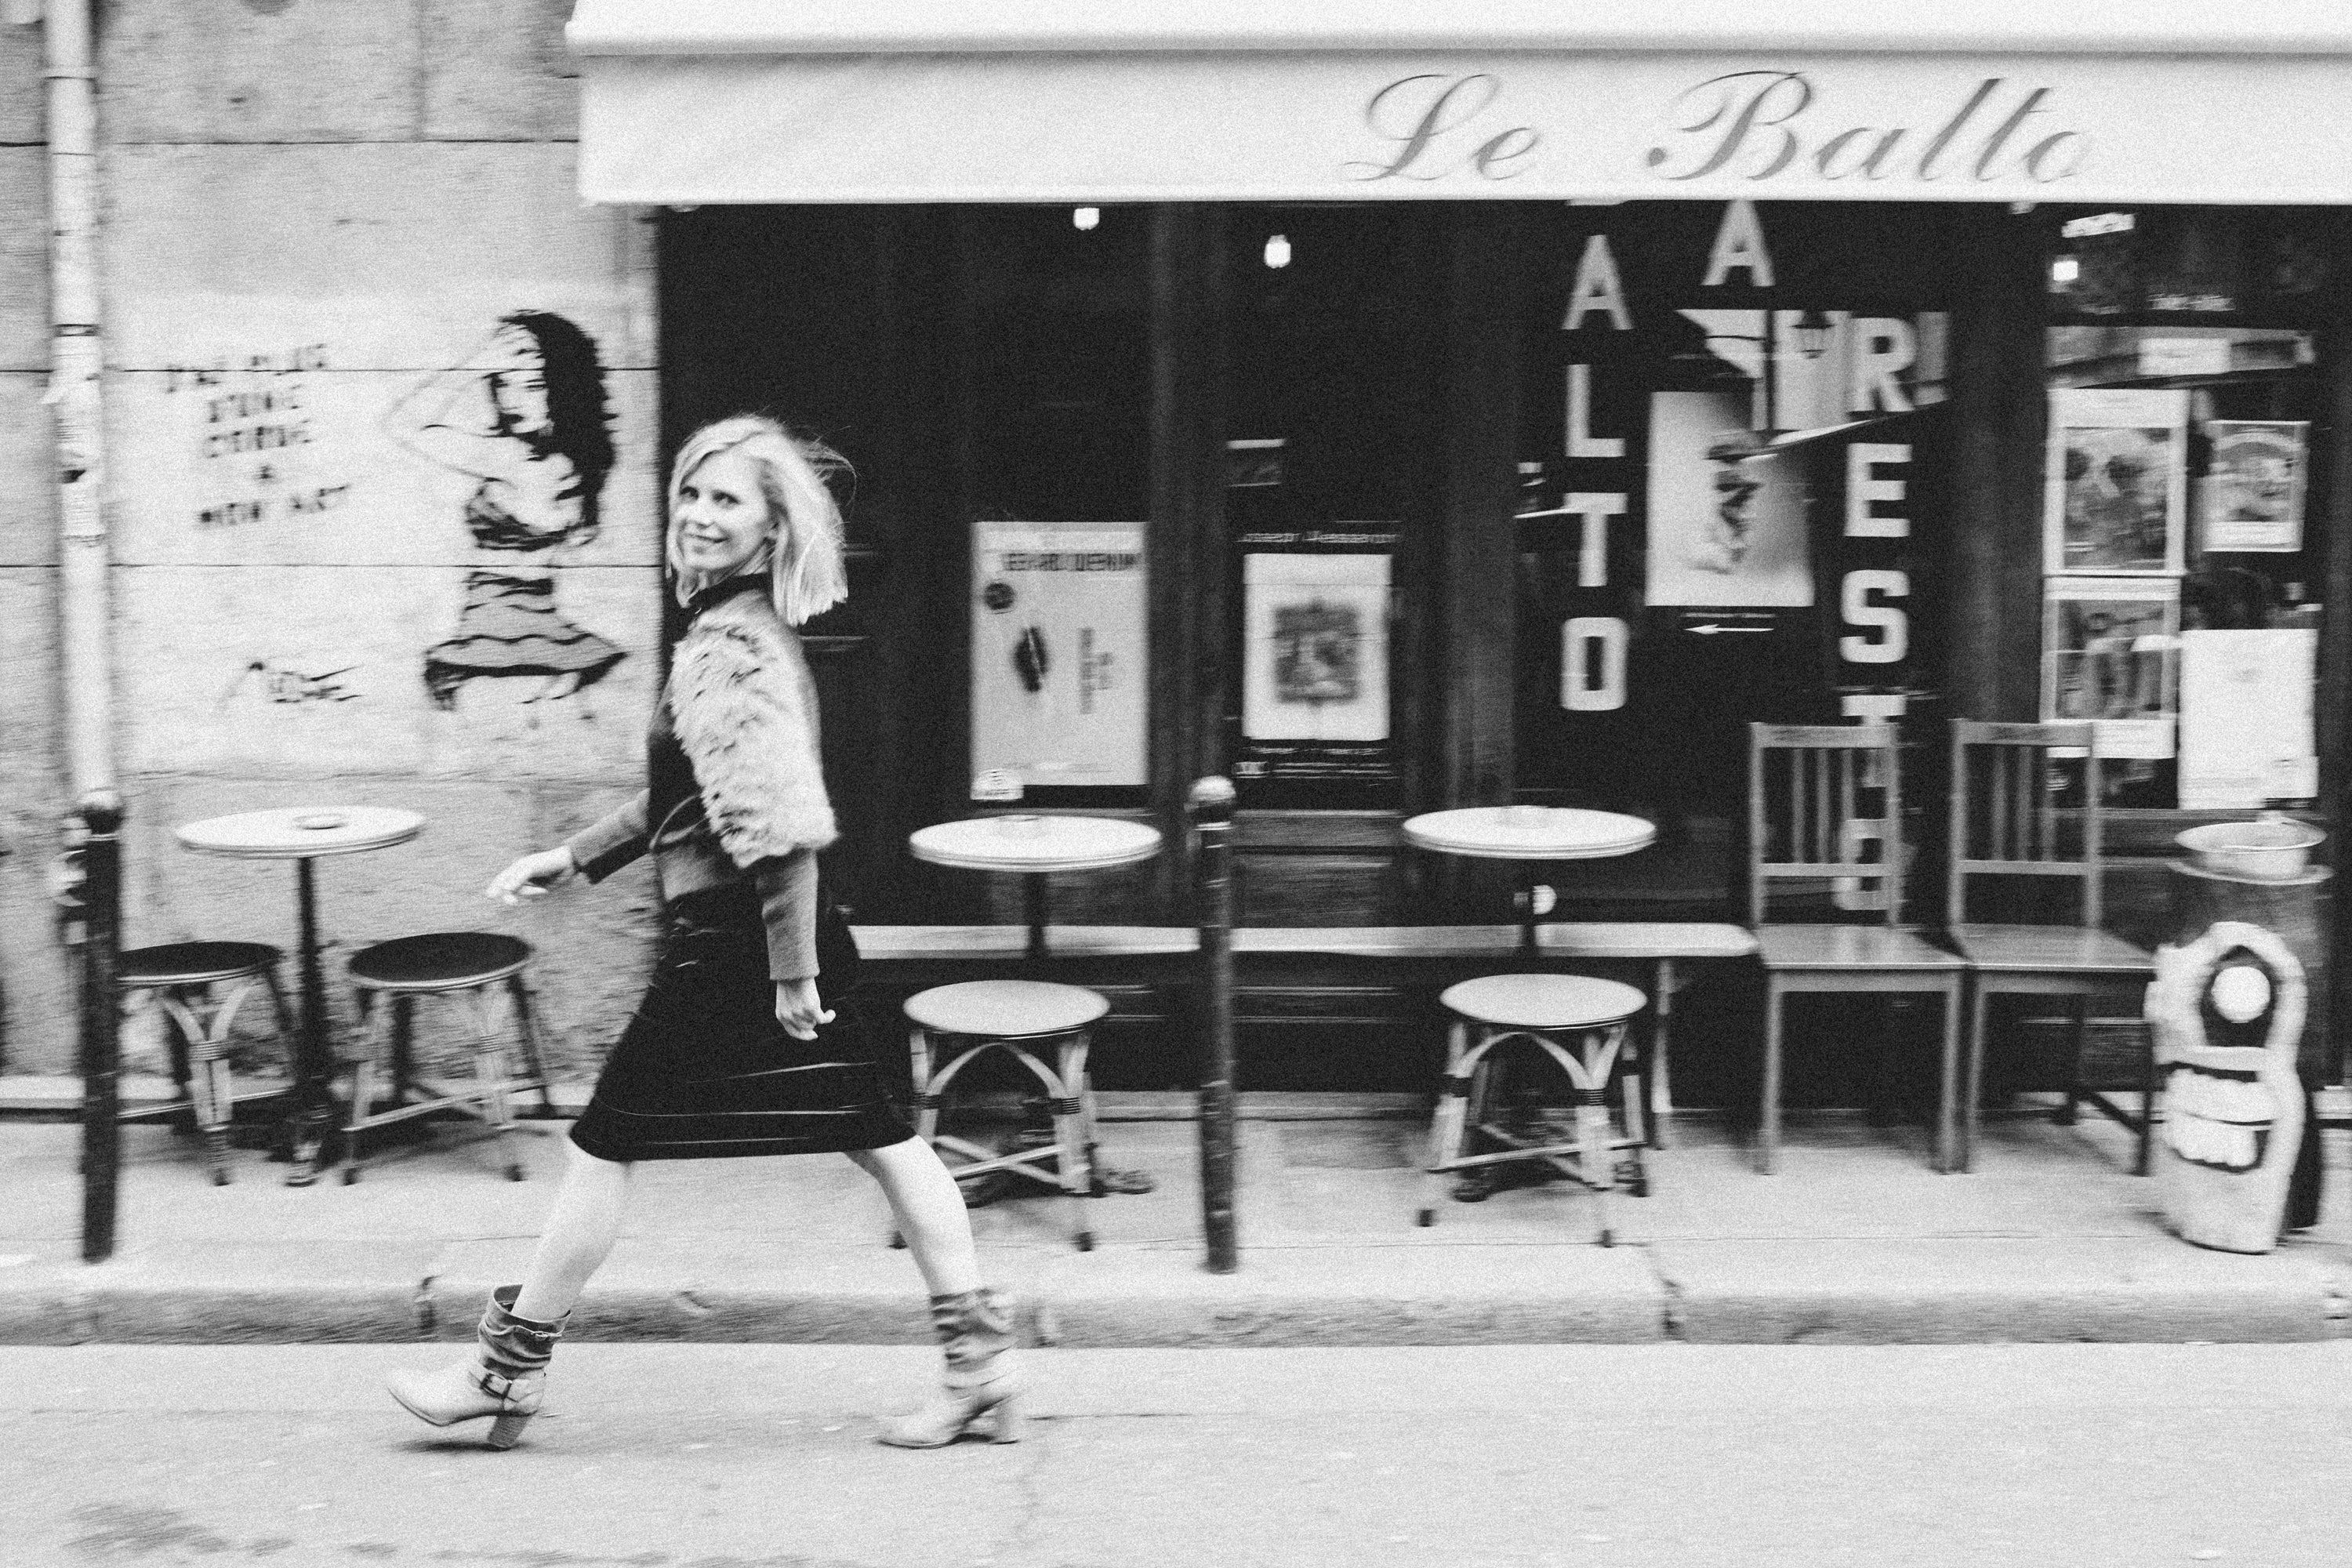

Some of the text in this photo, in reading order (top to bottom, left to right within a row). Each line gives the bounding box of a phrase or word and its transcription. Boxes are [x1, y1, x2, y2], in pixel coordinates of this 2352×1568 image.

[1343, 69, 2089, 183] Le Balto
[1560, 199, 1633, 710] ALTO
